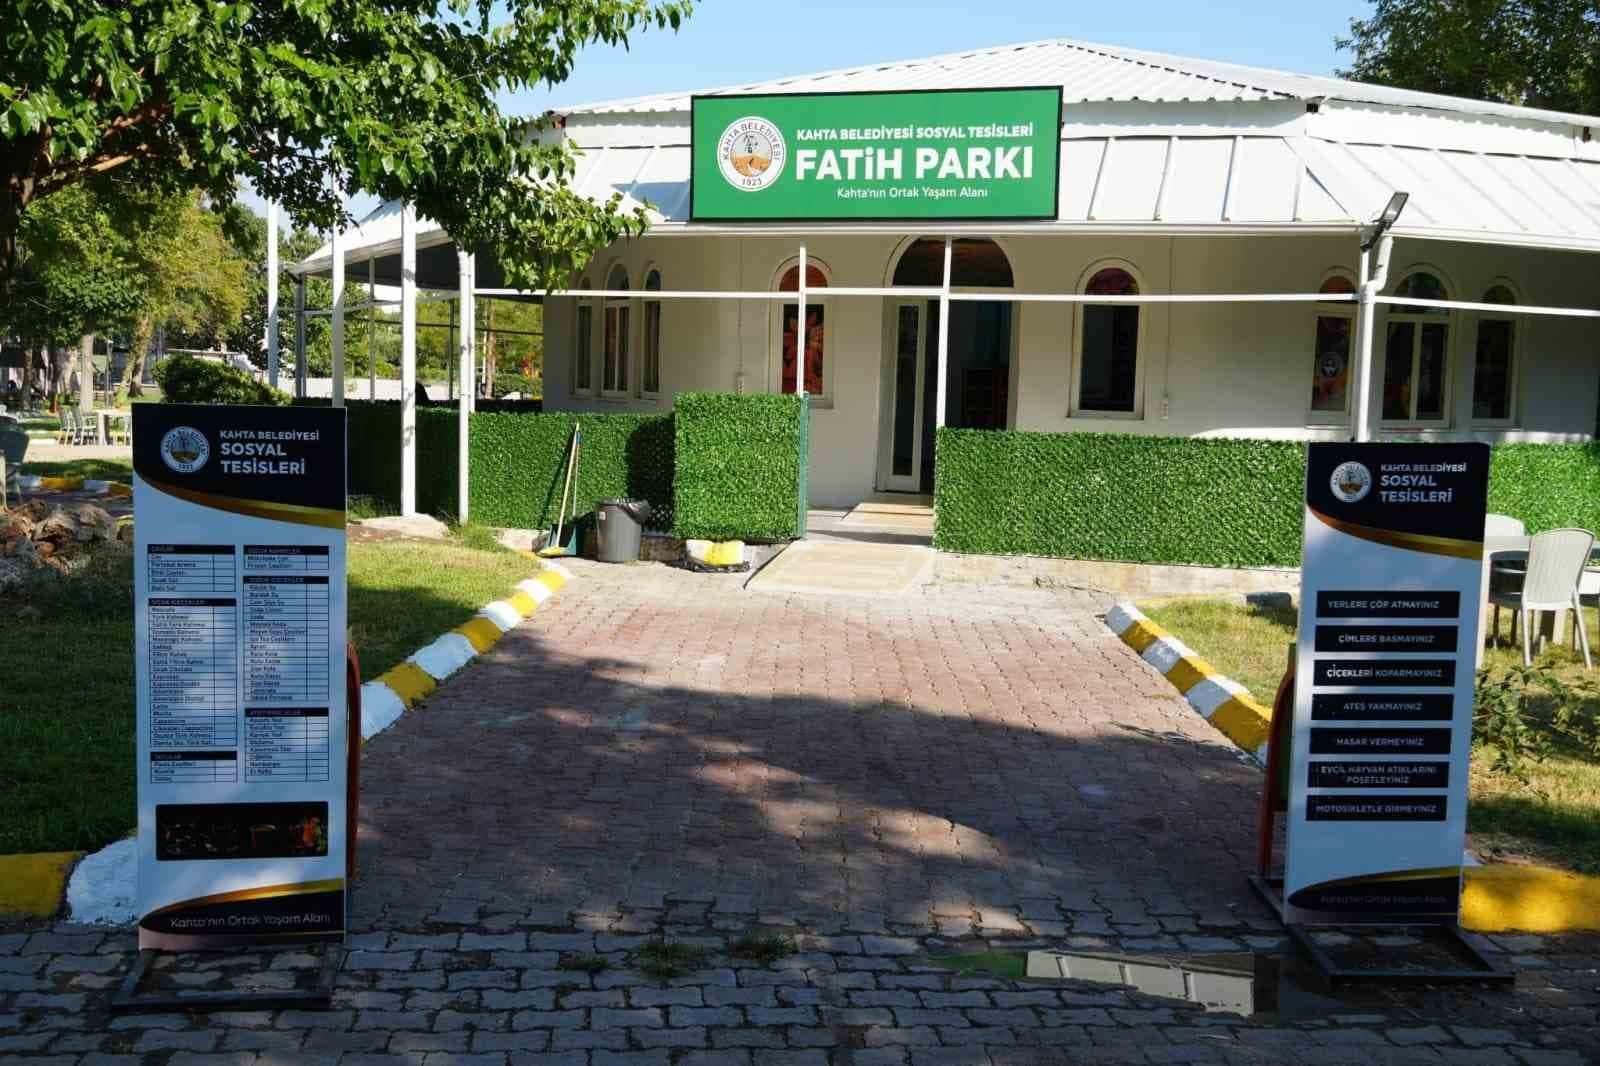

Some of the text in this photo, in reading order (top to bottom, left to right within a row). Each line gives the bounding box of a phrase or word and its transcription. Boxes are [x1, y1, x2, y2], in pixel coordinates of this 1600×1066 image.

[797, 122, 1034, 140] KAHTA BELEDİYESİ SOSYAL TESİSLERİ
[795, 146, 1034, 180] FATİH PARKI
[837, 187, 988, 201] Kahta'nın Ortak Yaşam Alanı
[220, 429, 320, 441] KAHTA BELEDİYESİ
[220, 443, 287, 456] SOSYAL
[220, 457, 305, 475] TESİSLERİ
[1381, 462, 1467, 472] KAHTA BELEDİYESİ
[1380, 474, 1437, 487] SOSYAL
[1380, 487, 1453, 503] TESİSLERİ
[1327, 600, 1368, 609] YERLERE
[1391, 600, 1440, 609] ATMAYINIZ
